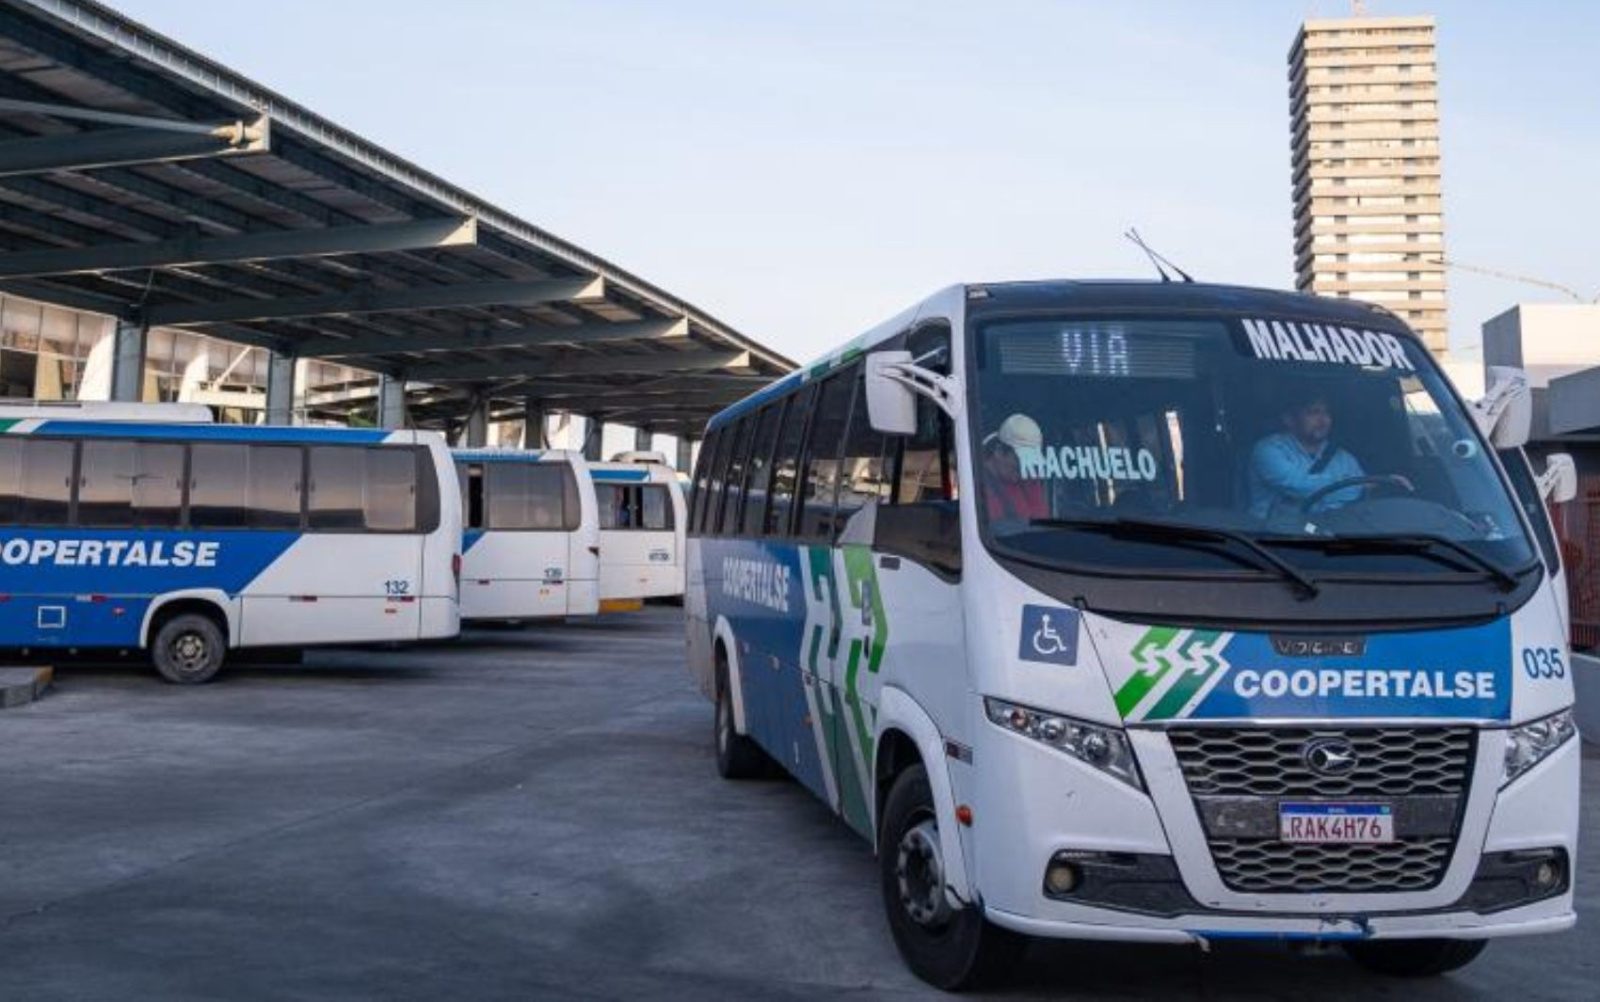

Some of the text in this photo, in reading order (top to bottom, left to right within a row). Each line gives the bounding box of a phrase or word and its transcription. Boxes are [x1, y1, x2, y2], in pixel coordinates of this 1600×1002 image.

[1062, 332, 1129, 375] VIA
[1241, 319, 1416, 371] MALHADOR
[0, 538, 220, 567] OPERTALSE
[384, 580, 409, 595] 132
[1522, 647, 1565, 680] 035
[1233, 669, 1496, 700] COOPERTALSE
[1291, 816, 1382, 839] RAK4H76
